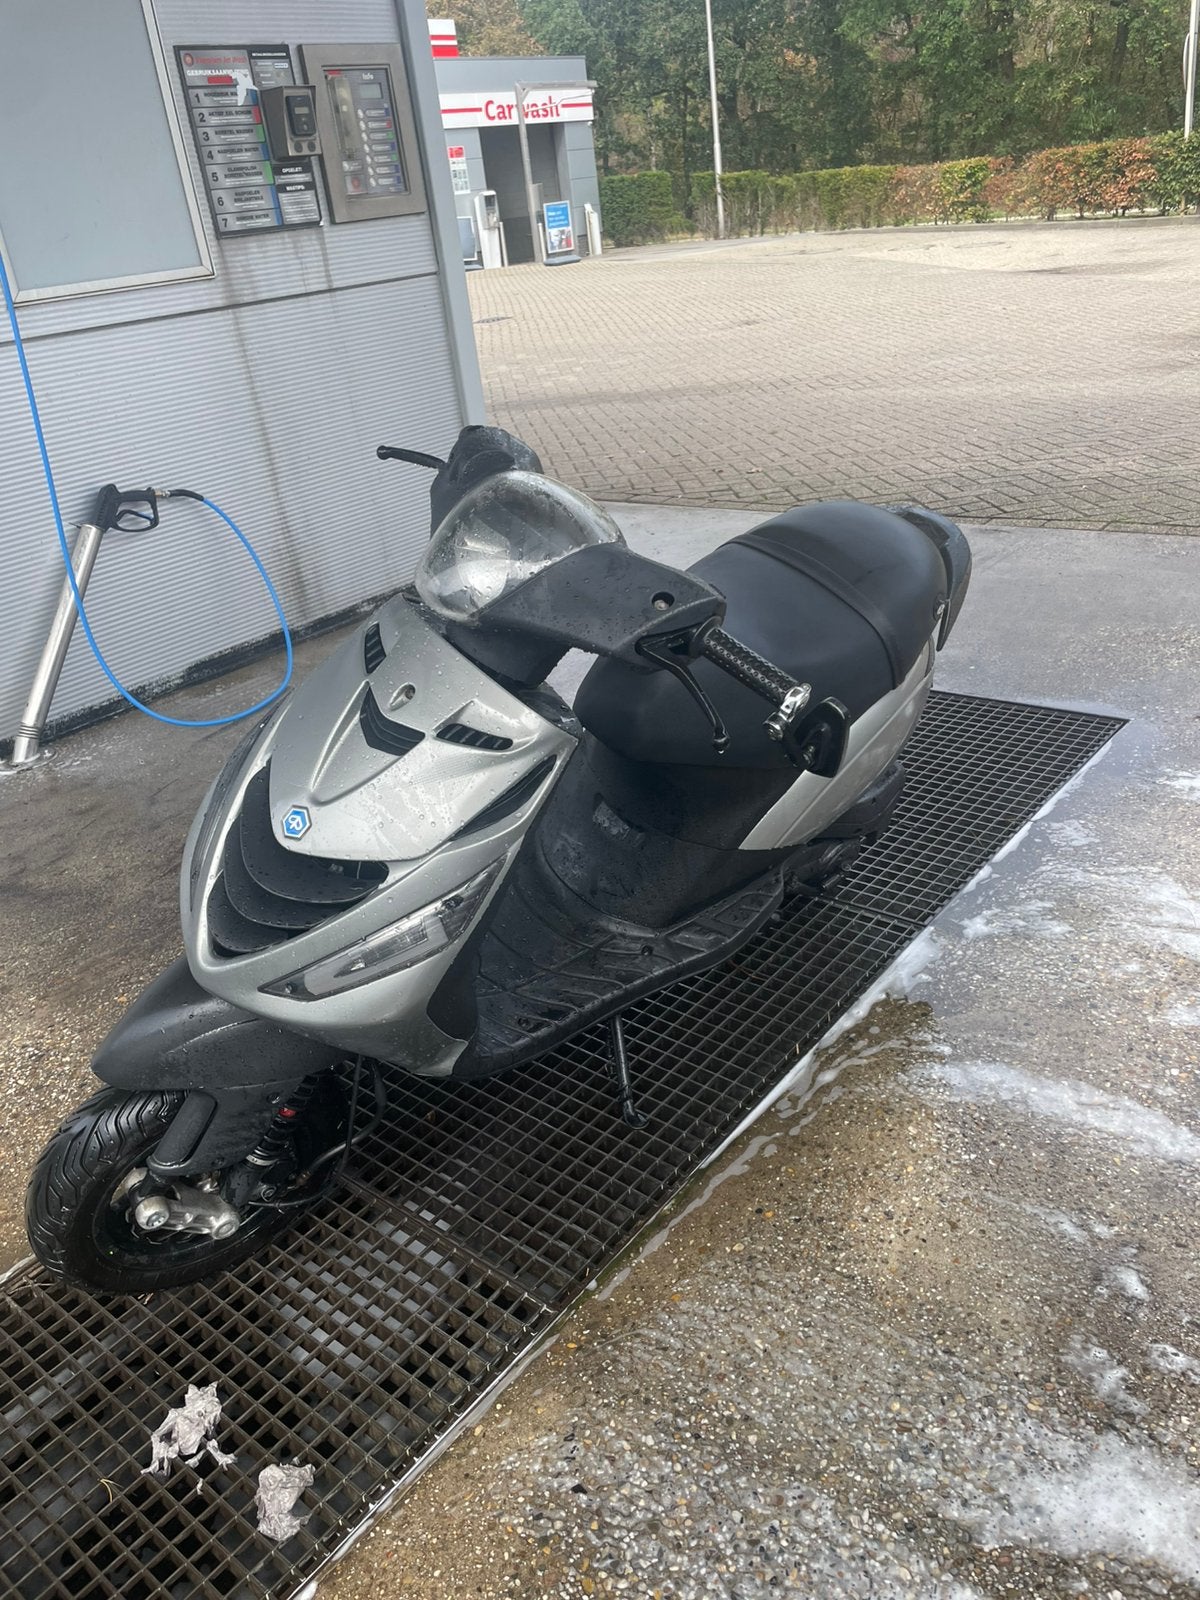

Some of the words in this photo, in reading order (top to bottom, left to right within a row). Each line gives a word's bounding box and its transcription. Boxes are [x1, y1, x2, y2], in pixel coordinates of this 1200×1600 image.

[194, 93, 201, 103] 1
[198, 112, 206, 122] 2
[202, 131, 210, 141] 3
[207, 150, 214, 160] 4
[211, 172, 219, 182] 5
[217, 196, 224, 206] 6
[221, 218, 228, 228] 7
